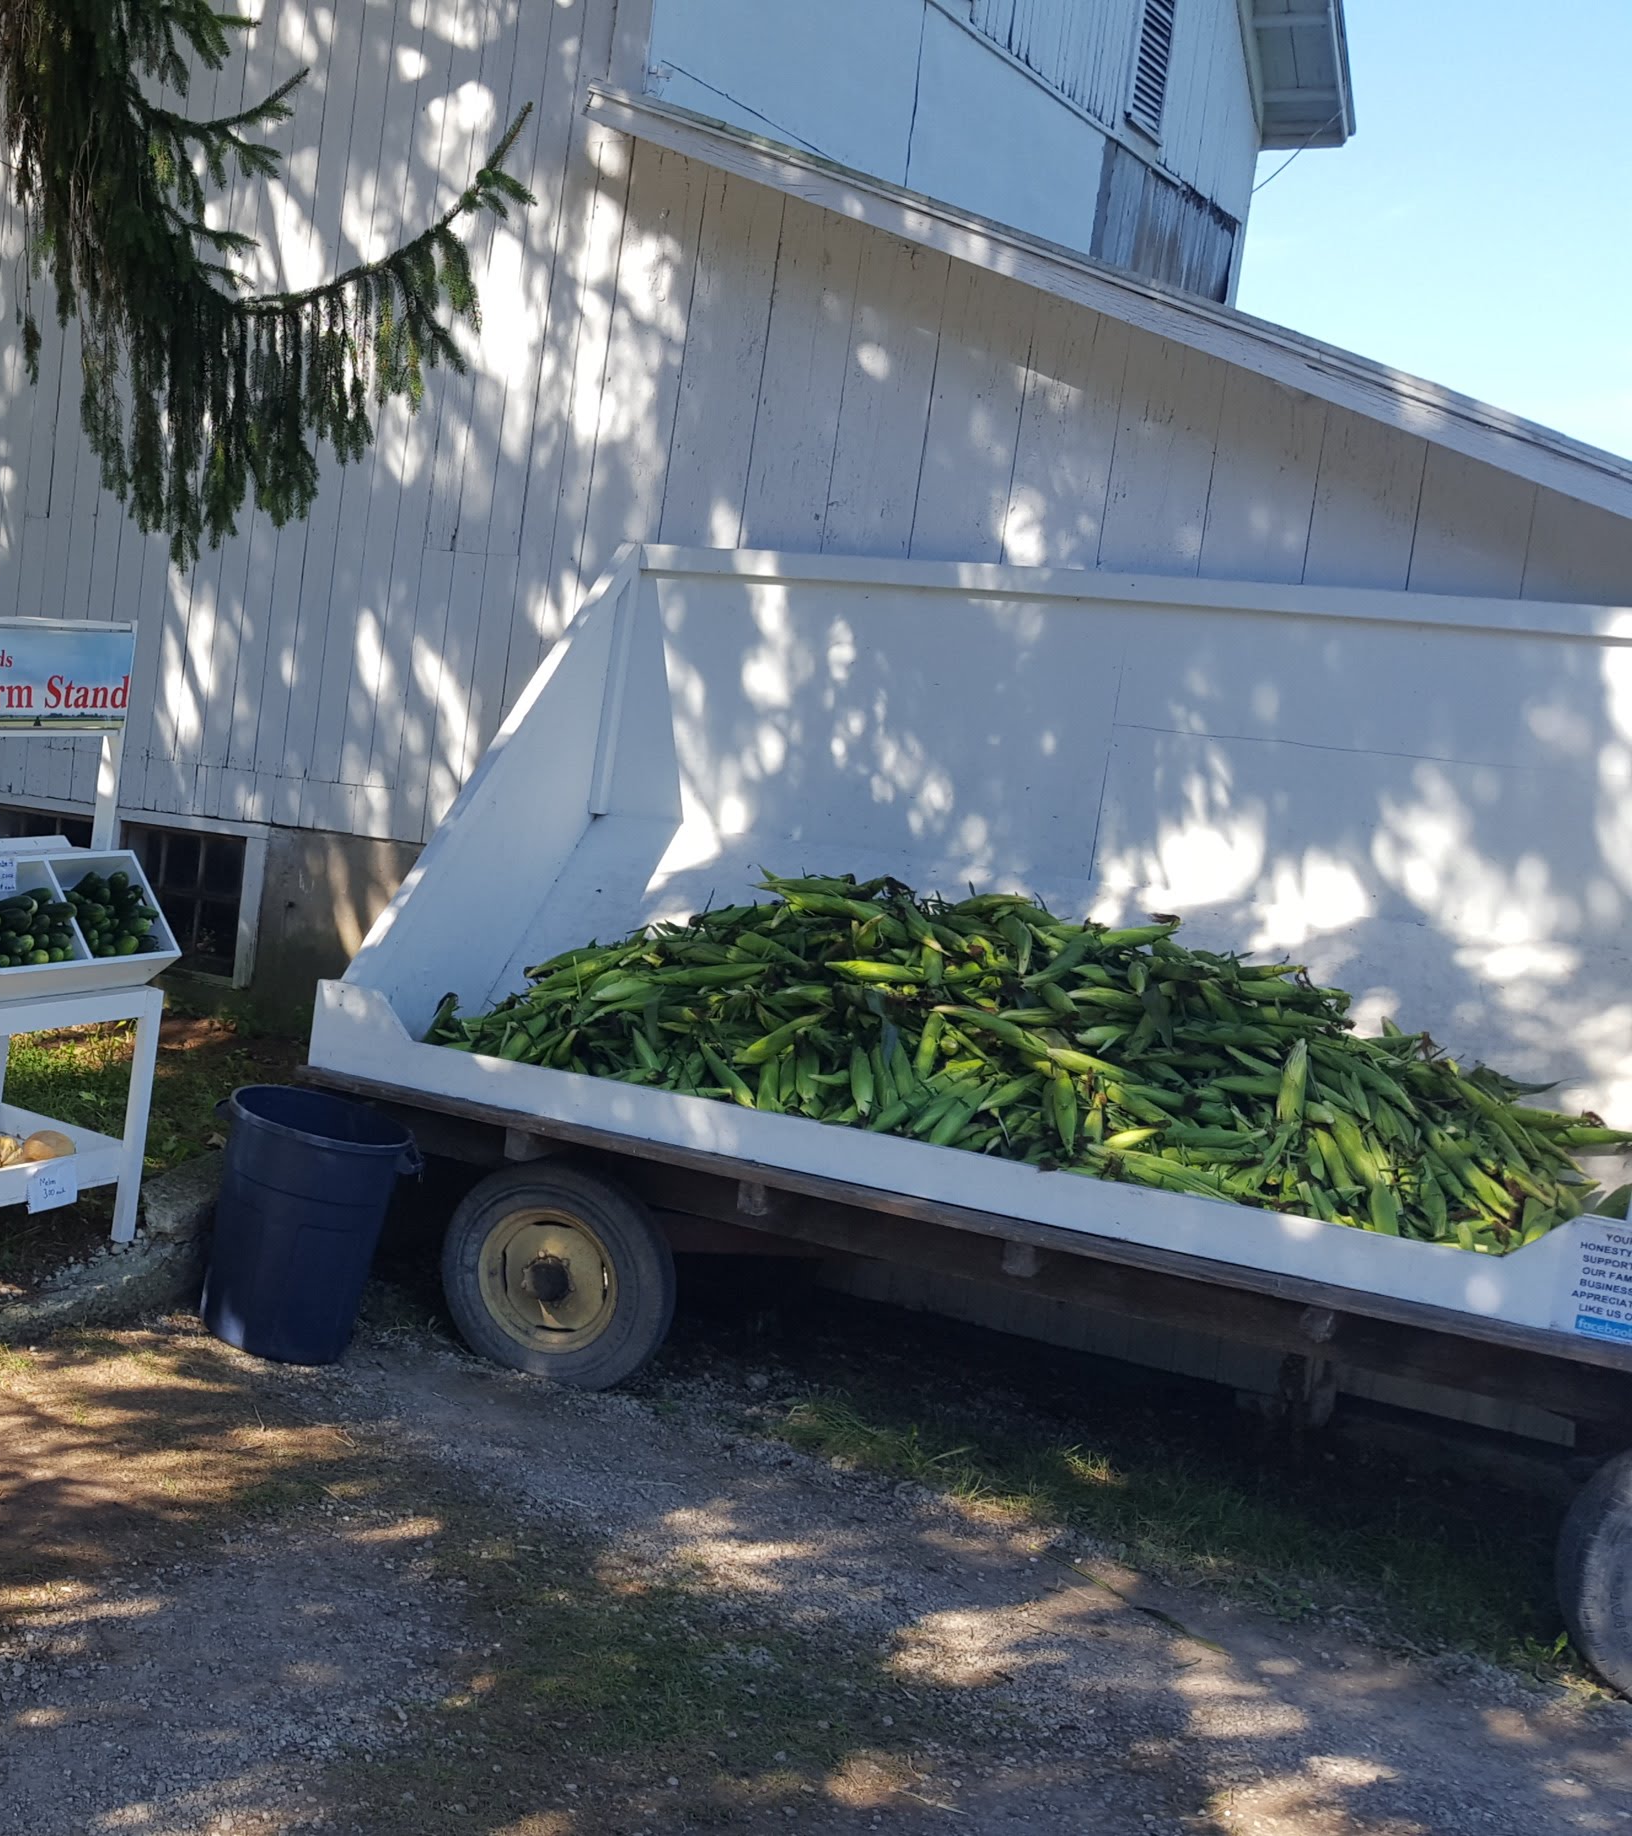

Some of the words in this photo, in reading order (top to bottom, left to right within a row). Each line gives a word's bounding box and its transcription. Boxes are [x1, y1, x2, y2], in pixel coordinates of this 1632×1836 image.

[44, 674, 130, 709] Stand
[1580, 1241, 1632, 1258] HONESTY
[1582, 1266, 1606, 1279] OUR
[1578, 1303, 1604, 1316] LIKE
[1606, 1309, 1622, 1319] US
